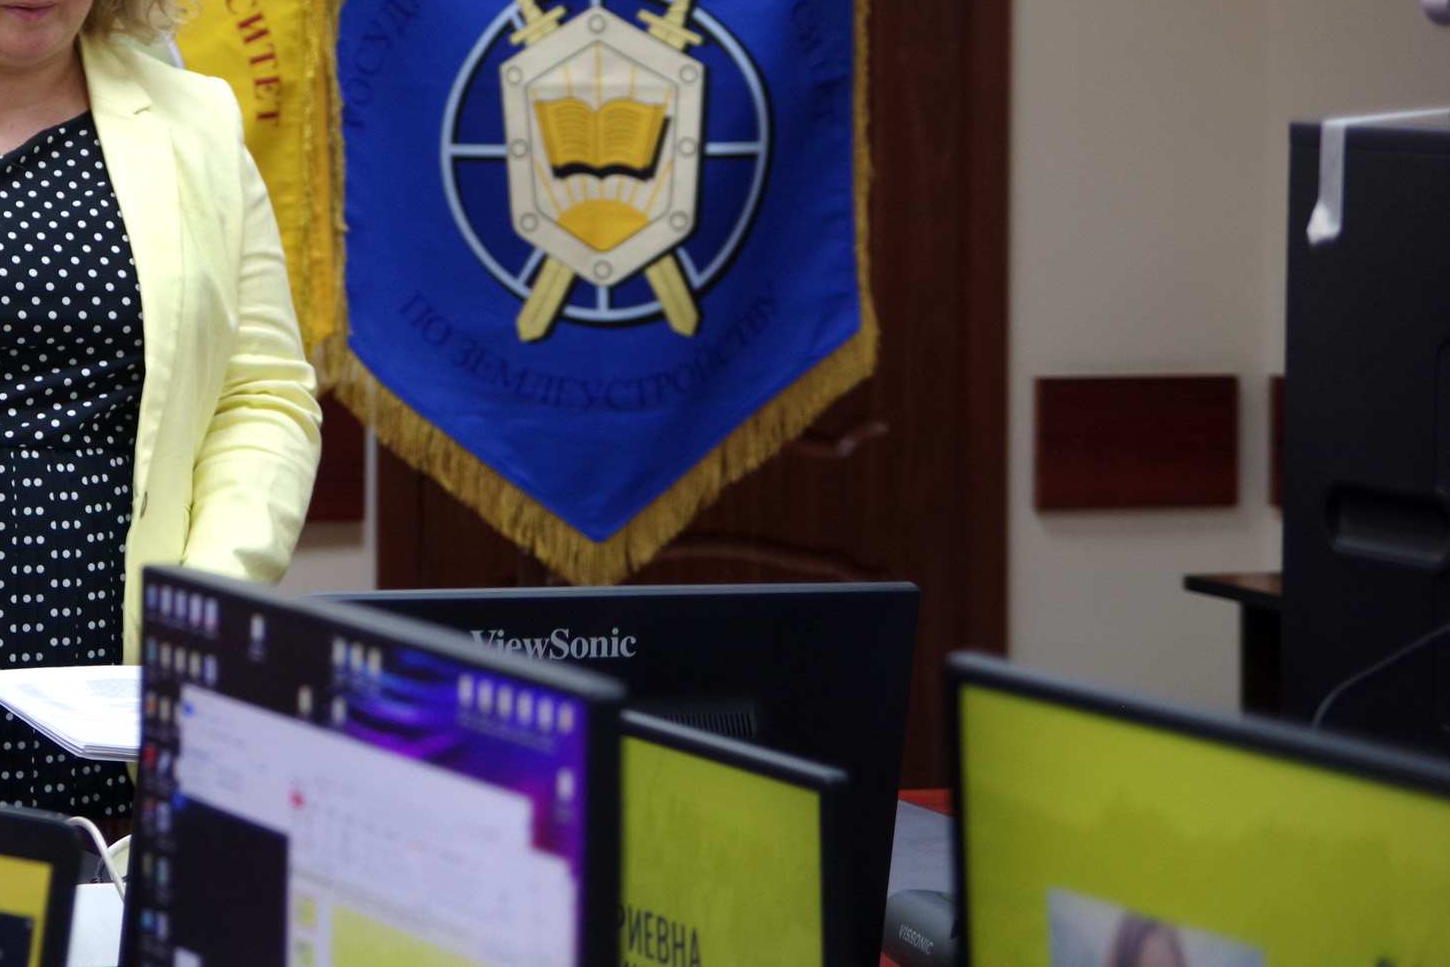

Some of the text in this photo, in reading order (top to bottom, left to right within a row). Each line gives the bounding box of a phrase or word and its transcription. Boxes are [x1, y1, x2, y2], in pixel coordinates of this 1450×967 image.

[398, 293, 452, 347] ПО
[470, 627, 637, 660] ViewSonic
[898, 924, 934, 955] VISSONIC
